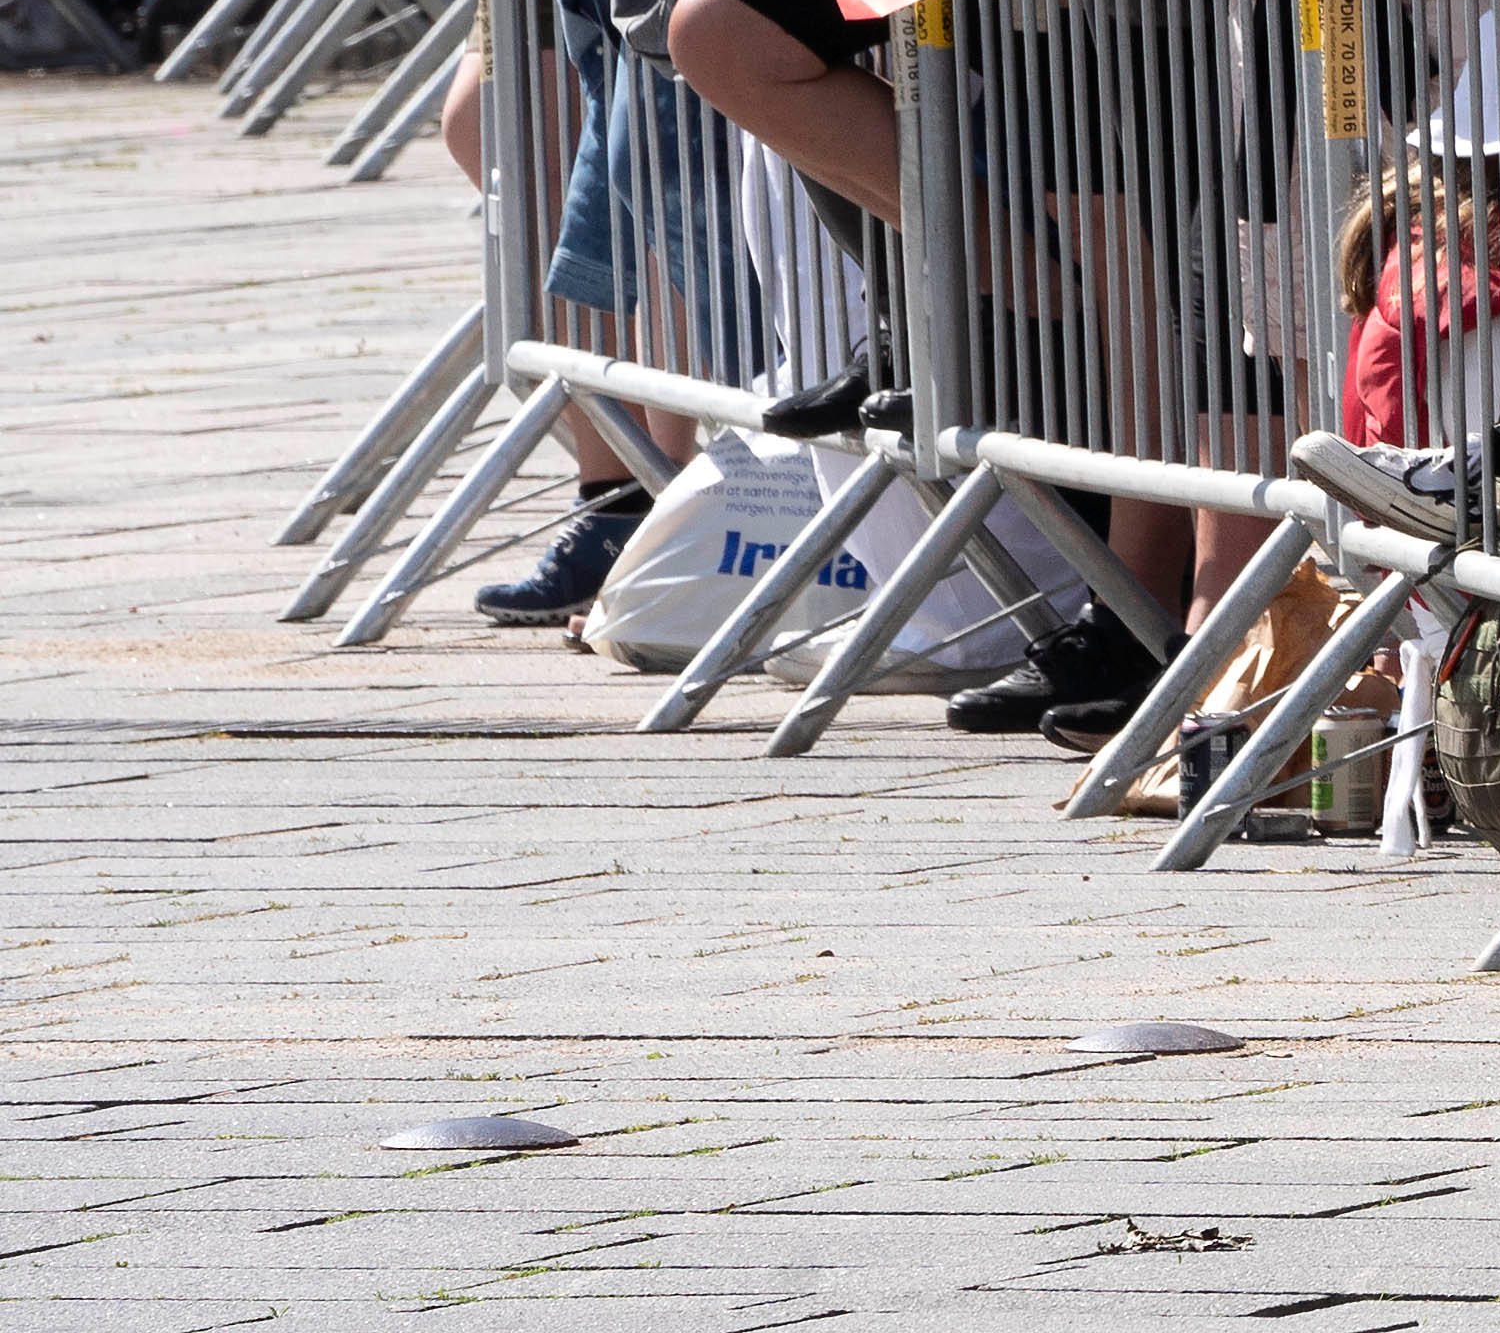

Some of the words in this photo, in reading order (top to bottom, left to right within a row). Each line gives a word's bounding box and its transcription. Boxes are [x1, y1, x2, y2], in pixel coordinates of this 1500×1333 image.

[901, 18, 914, 35] 70
[904, 39, 917, 58] 20
[1341, 41, 1355, 60] 70
[1342, 65, 1356, 84] 20
[1343, 90, 1356, 108] 18
[1343, 114, 1357, 133] 16
